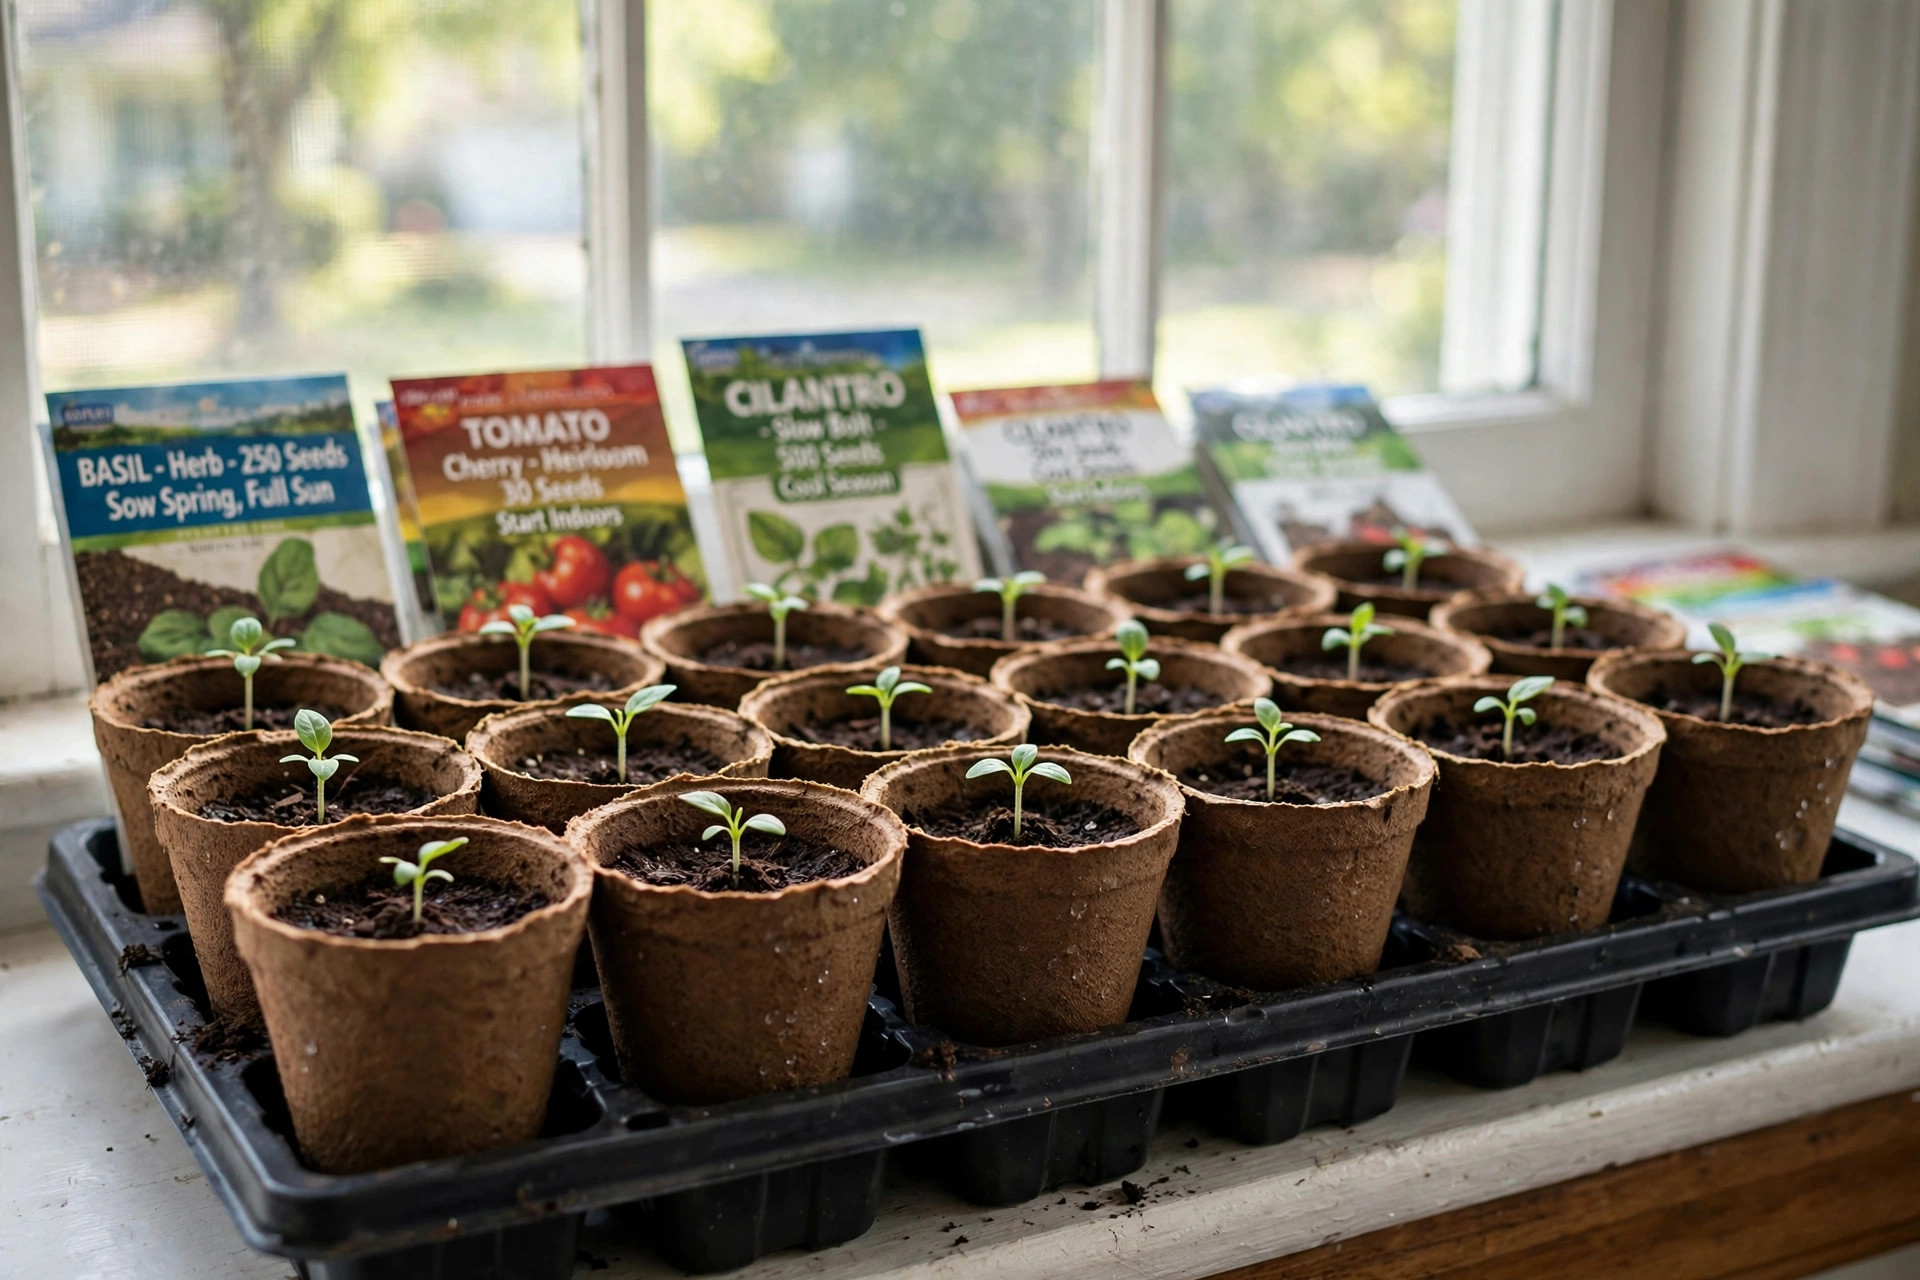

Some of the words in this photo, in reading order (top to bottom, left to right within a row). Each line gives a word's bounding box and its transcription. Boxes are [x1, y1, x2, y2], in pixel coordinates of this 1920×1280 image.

[724, 371, 906, 417] CILANTRO
[461, 409, 611, 449] TOMATO
[77, 454, 152, 488] BASIL
[167, 446, 224, 480] Herb
[238, 444, 282, 475] 250
[286, 437, 348, 471] Seeds
[443, 452, 523, 481] Cherry
[541, 445, 649, 474] Heirloom
[105, 491, 156, 521] Sow
[160, 483, 243, 522] Spring,
[245, 476, 289, 508] Full
[291, 476, 335, 504] Sun
[535, 473, 604, 500] Seeds
[496, 509, 547, 535] Start
[549, 505, 623, 530] Indoors
